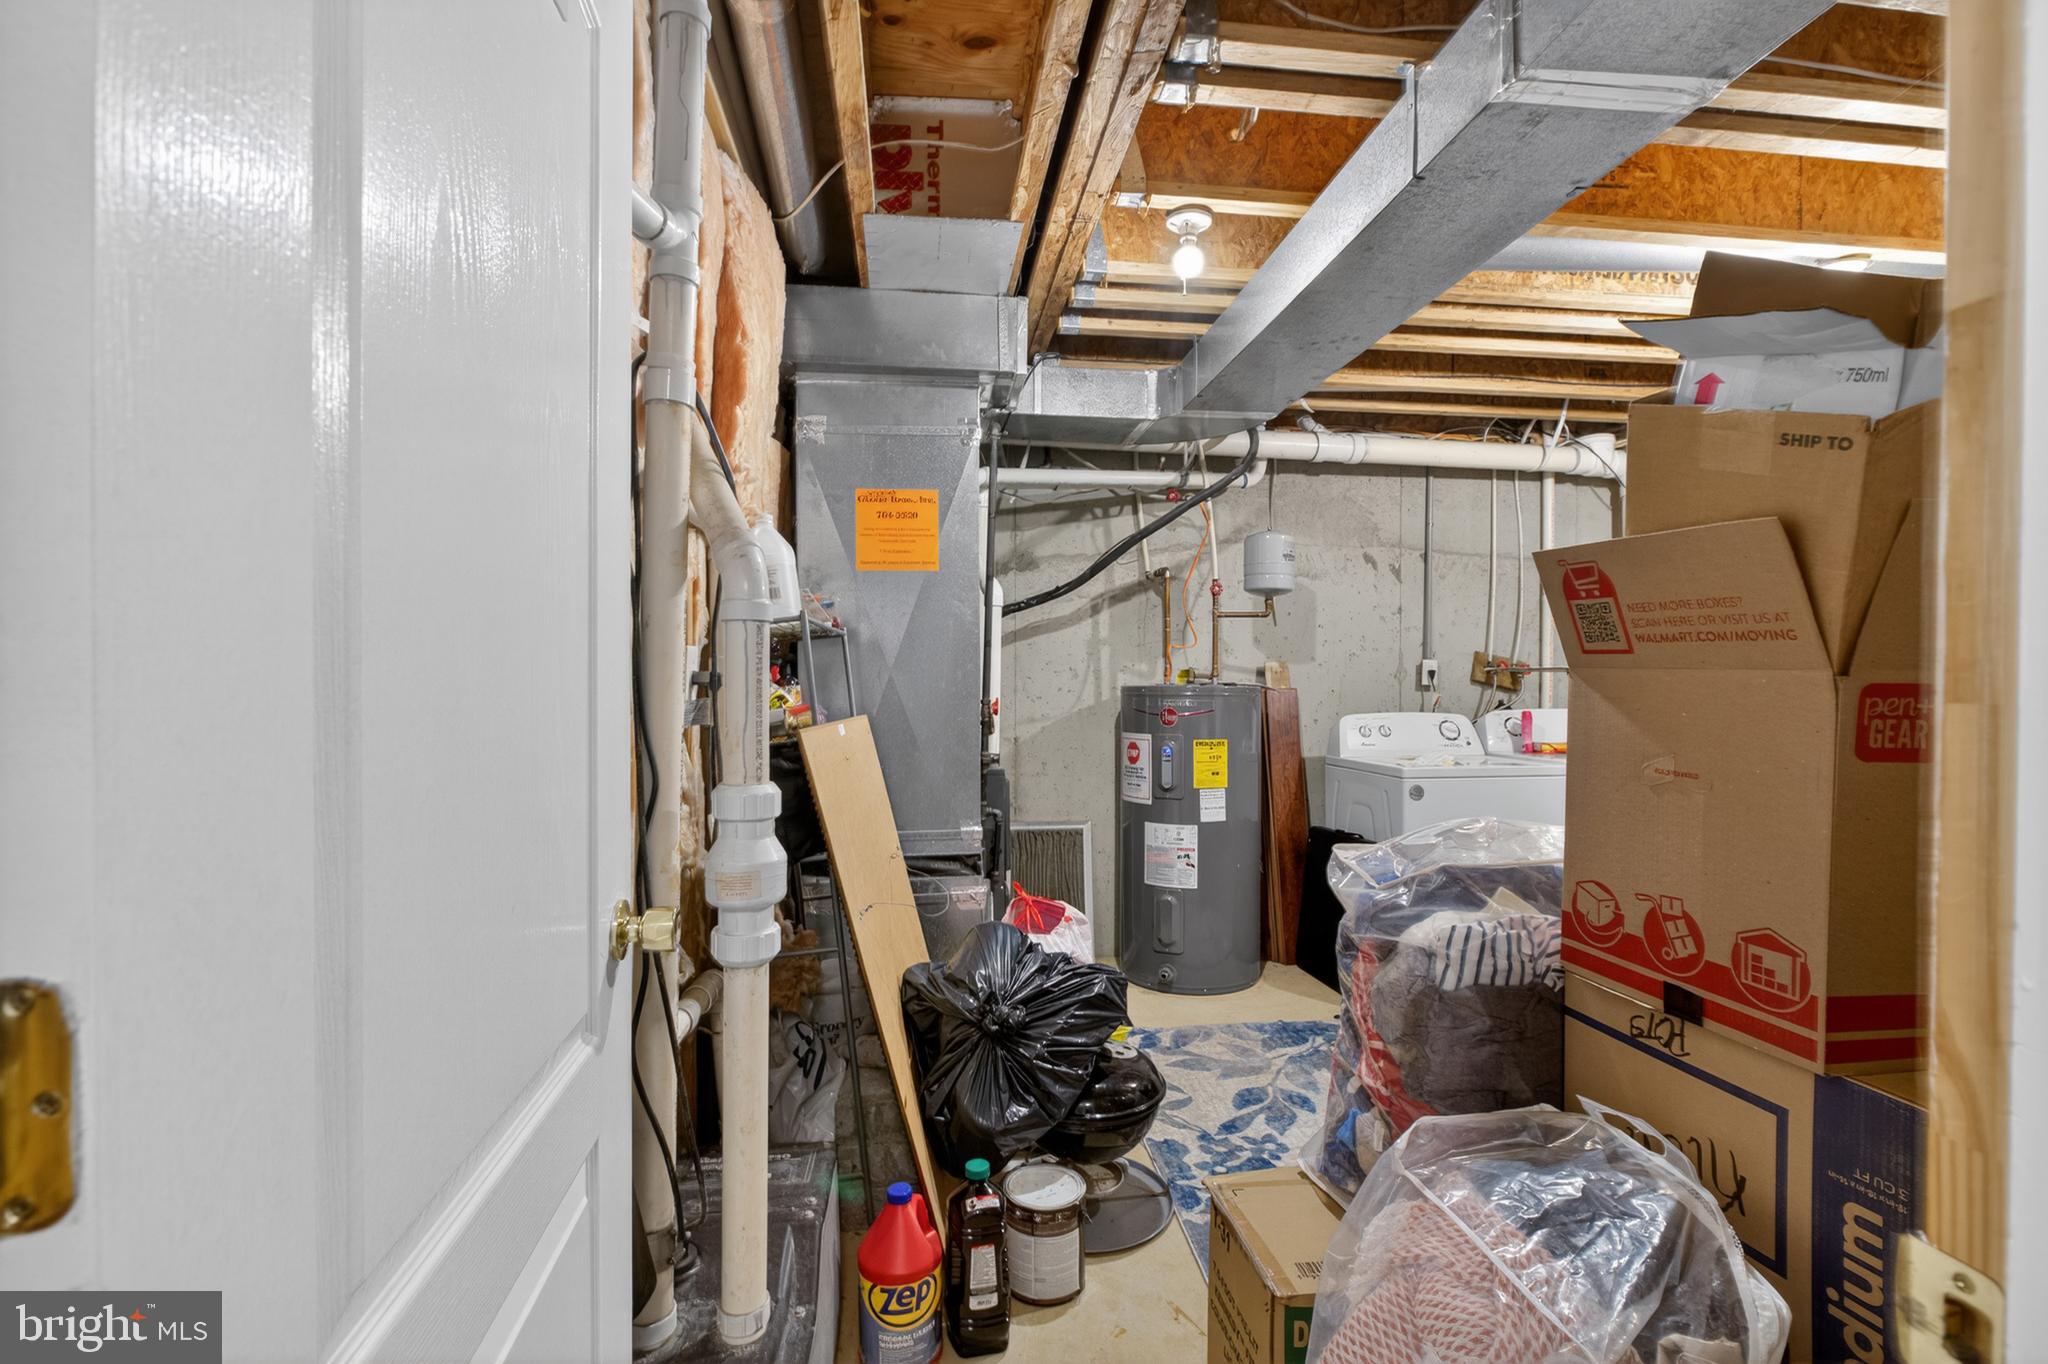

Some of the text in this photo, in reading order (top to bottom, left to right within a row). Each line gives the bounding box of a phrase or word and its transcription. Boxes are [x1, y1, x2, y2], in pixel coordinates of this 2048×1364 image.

[1846, 367, 1890, 383] 750ml
[1779, 432, 1854, 451] SHIP TO
[1627, 596, 1743, 613] NEED MORE BOXES?
[1632, 611, 1791, 629] SCAN HERE OR VISIT US AT
[1635, 628, 1799, 643] WALMART.COM/MOVING
[1869, 719, 1930, 749] GEAR
[1853, 1167, 1870, 1184] FT
[1873, 1176, 1896, 1194] CU
[1826, 1201, 1885, 1364] dium
[879, 1279, 932, 1316] Zep
